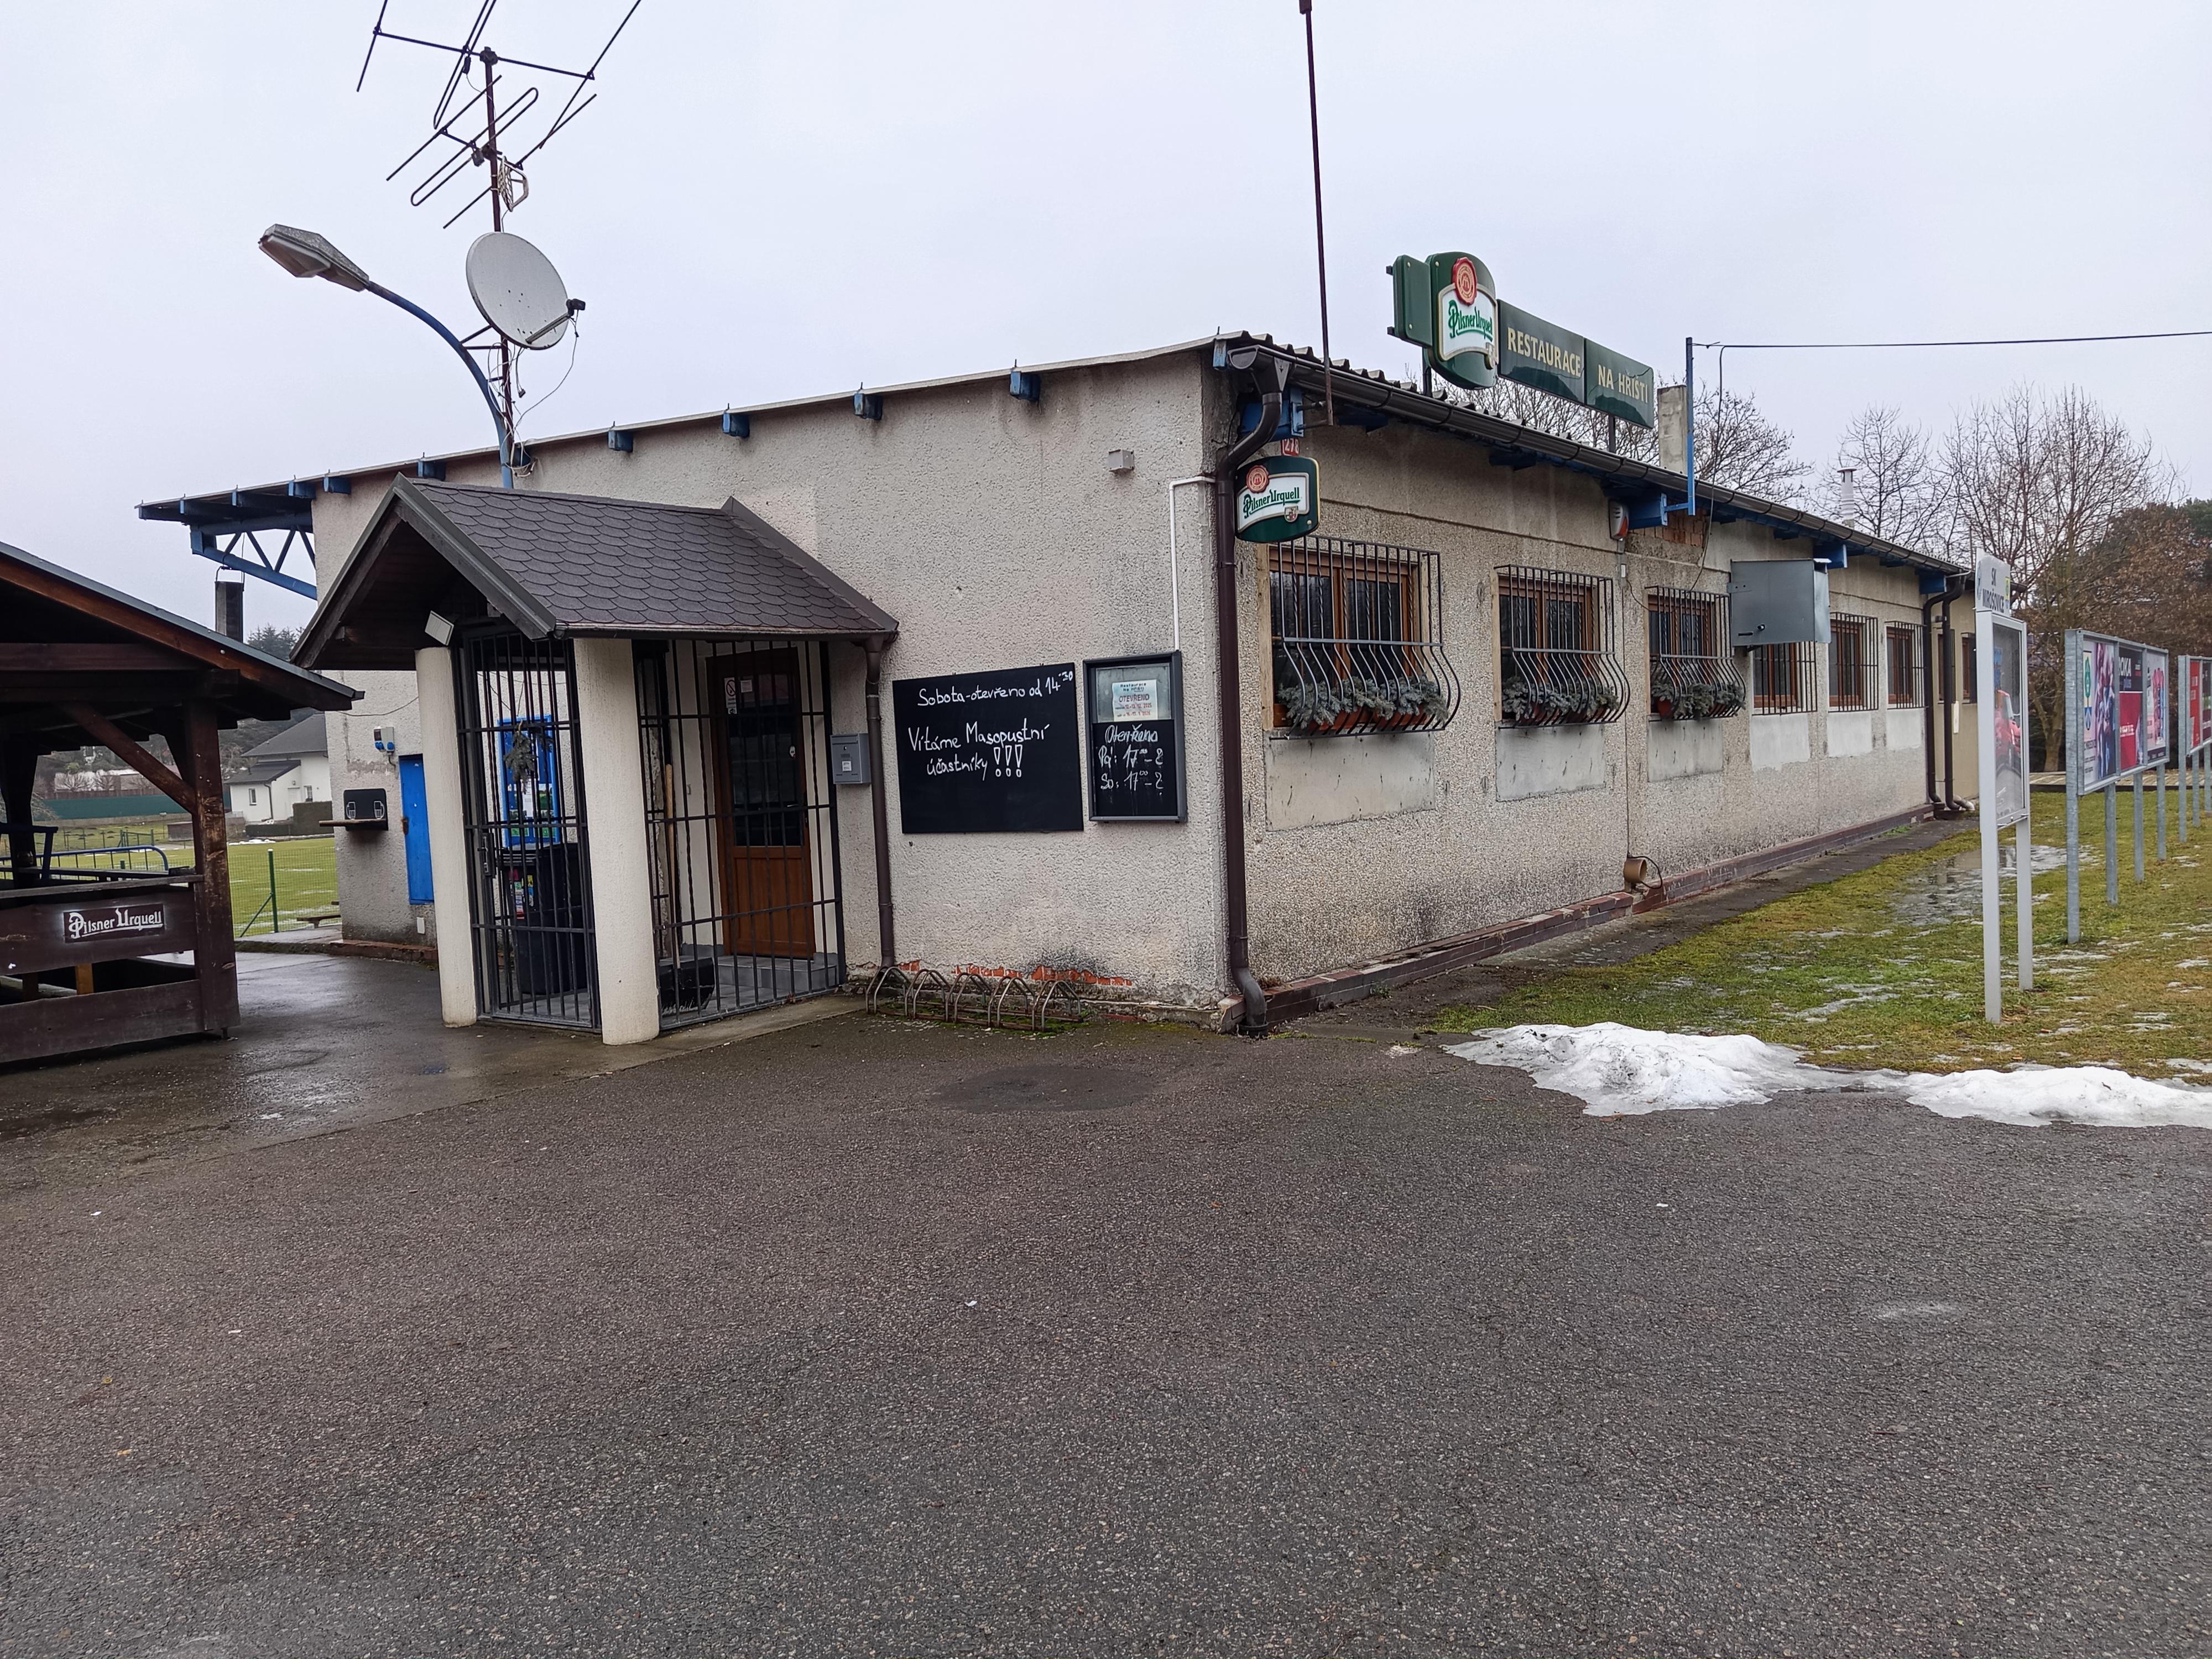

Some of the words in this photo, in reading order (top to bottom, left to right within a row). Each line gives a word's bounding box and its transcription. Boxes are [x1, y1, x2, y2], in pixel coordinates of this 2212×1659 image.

[1448, 300, 1475, 338] Pilsner
[1507, 327, 1581, 377] RESTAURACE
[1597, 364, 1615, 390] NA
[1285, 438, 1299, 454] 278
[1243, 493, 1270, 519] Pilsner
[1269, 487, 1300, 505] Urquell
[1029, 678, 1042, 697] od
[1119, 693, 1150, 703] OTEVŘENO
[908, 726, 961, 751] Vítáme
[966, 718, 1050, 748] Masopustní
[927, 752, 988, 781] účastníky
[69, 912, 115, 939] Pilsner
[115, 907, 162, 931] Urquell
